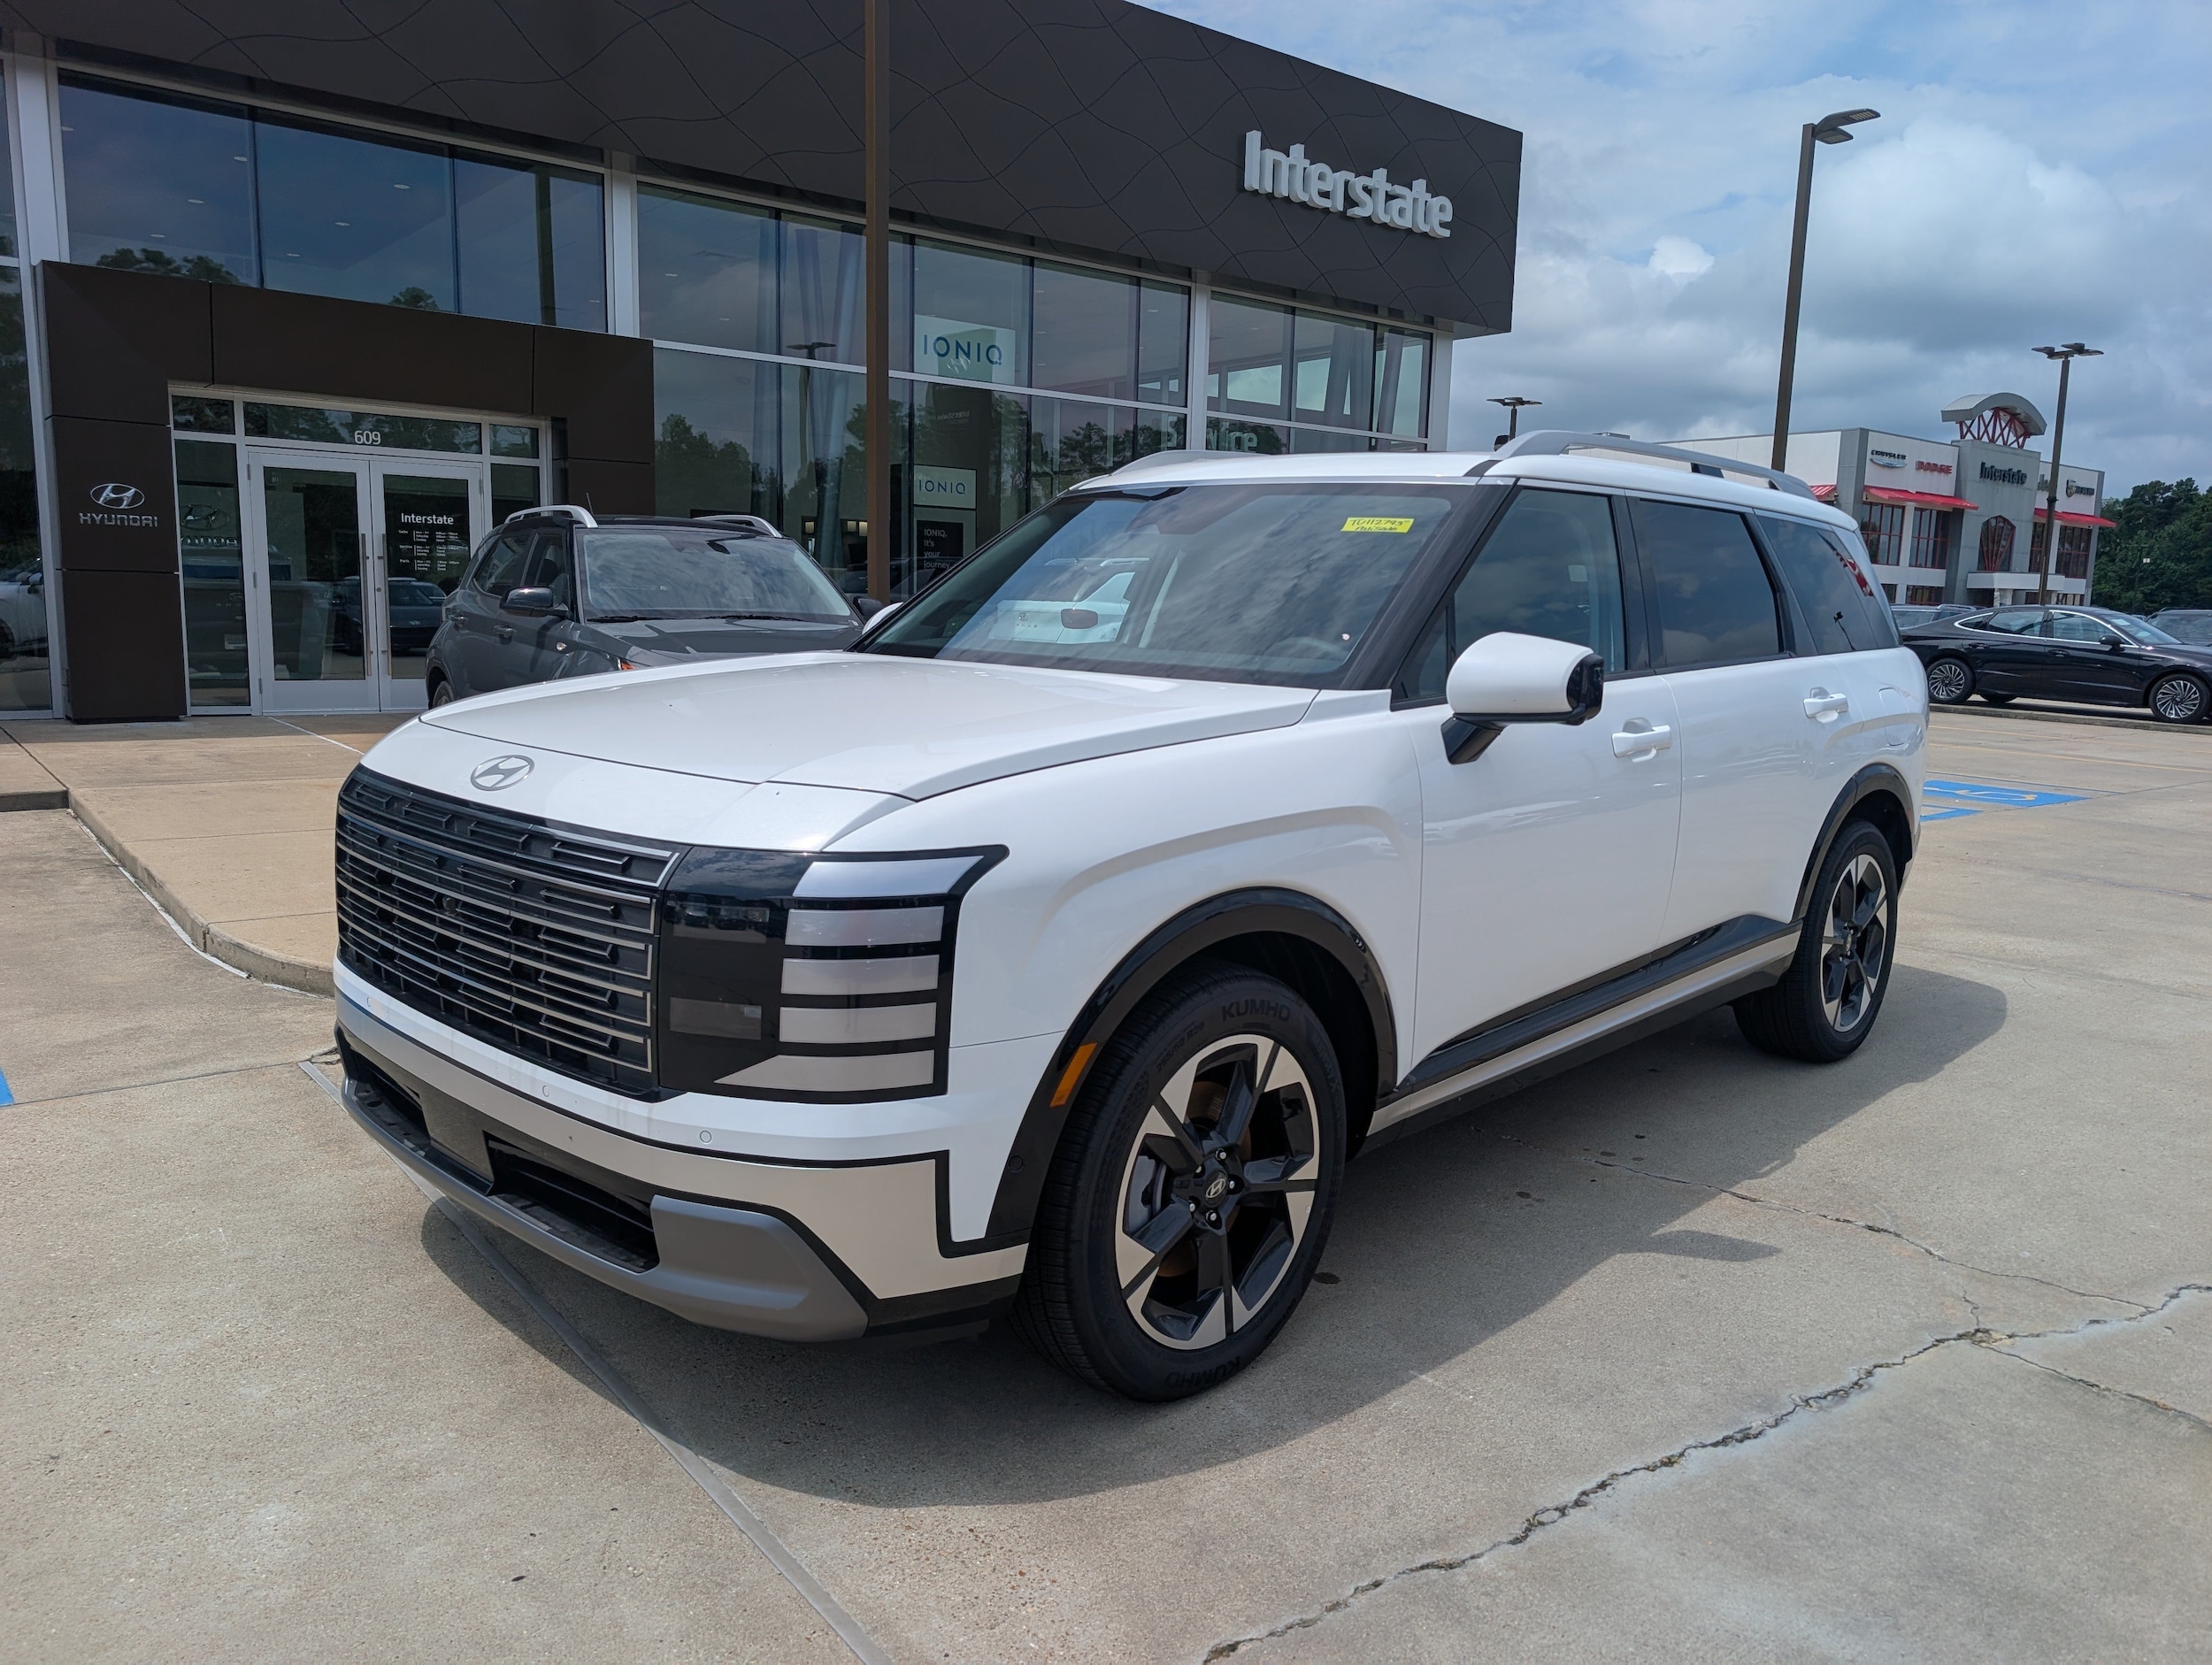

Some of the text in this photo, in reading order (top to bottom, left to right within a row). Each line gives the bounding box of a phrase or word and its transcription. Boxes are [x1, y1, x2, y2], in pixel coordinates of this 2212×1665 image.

[1243, 129, 1454, 239] Interstate
[923, 334, 1002, 366] IONIQ
[354, 430, 381, 445] 609
[1916, 461, 1953, 474] DODGE
[1979, 461, 2028, 486] Interstate
[918, 479, 966, 495] IONIQ
[79, 512, 158, 527] HYUNDAI
[401, 512, 454, 525] Interstate
[1221, 998, 1291, 1022] KUMHO
